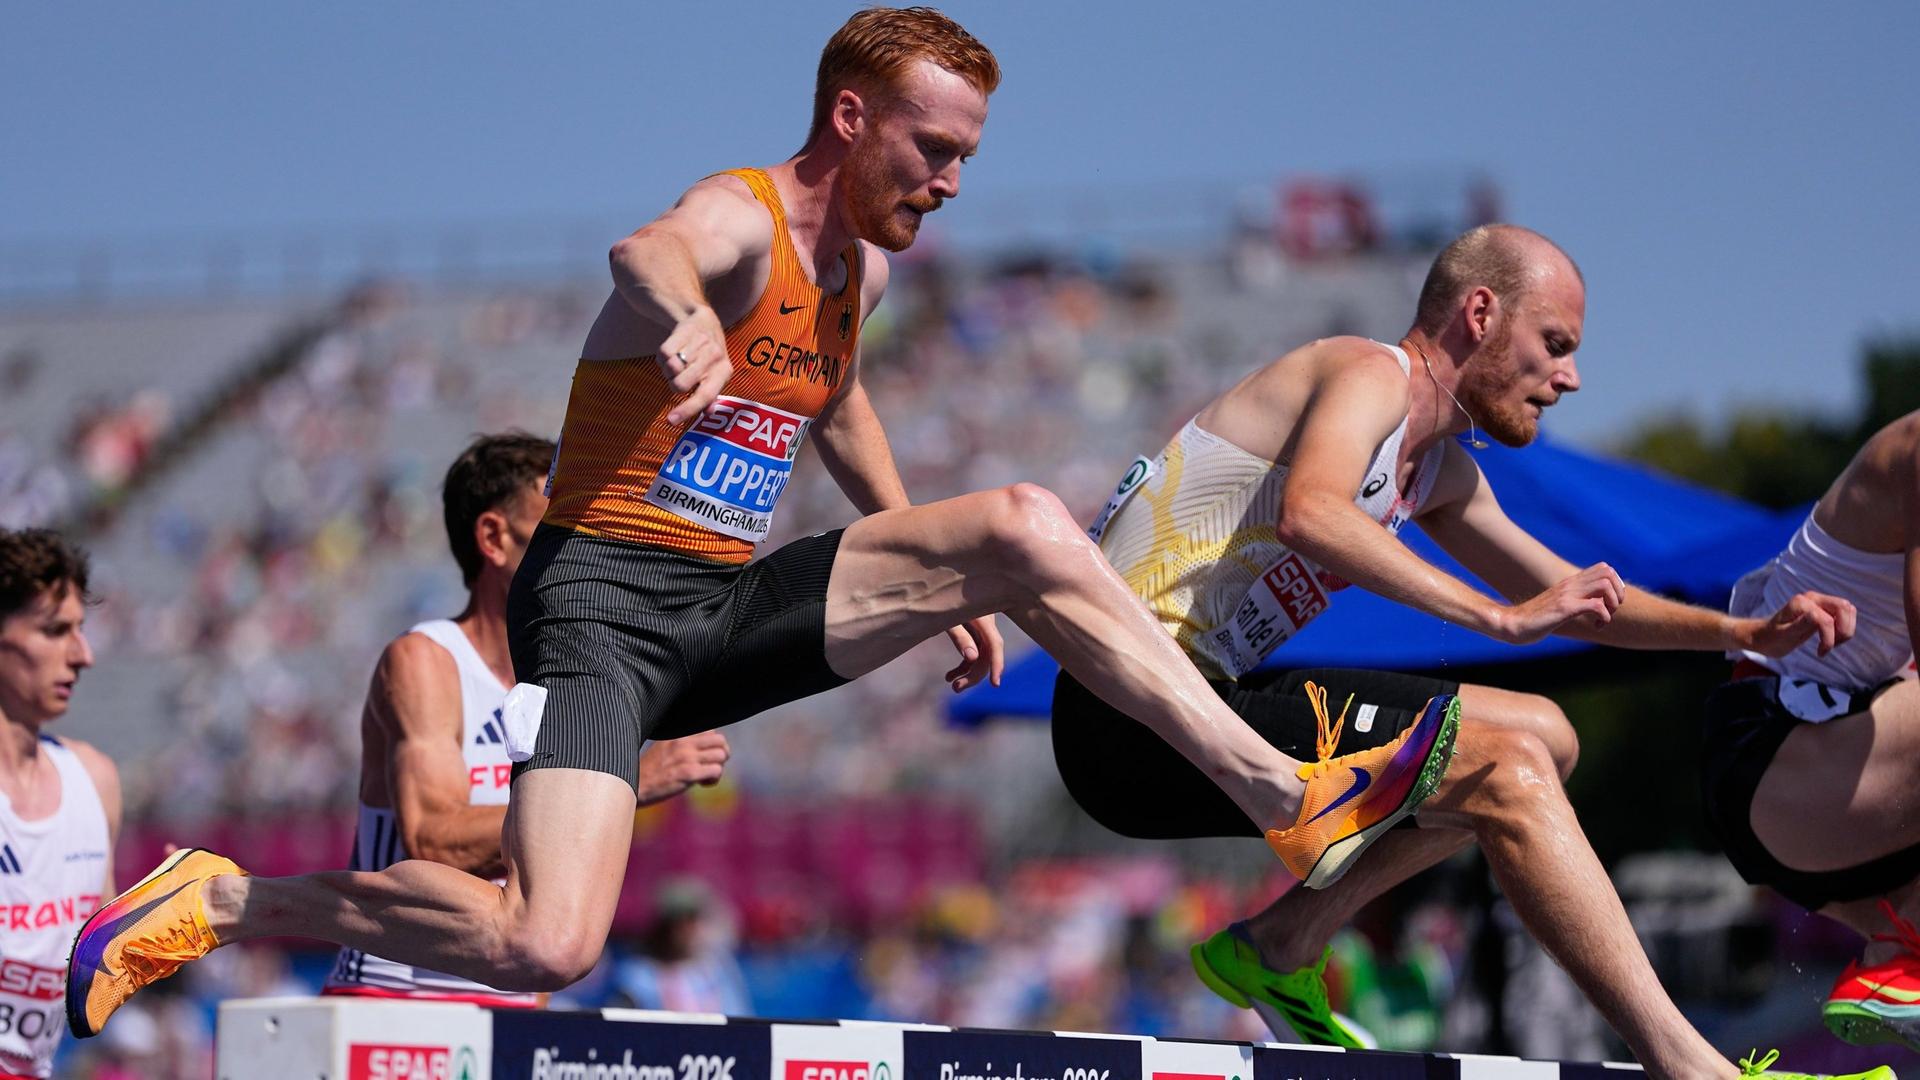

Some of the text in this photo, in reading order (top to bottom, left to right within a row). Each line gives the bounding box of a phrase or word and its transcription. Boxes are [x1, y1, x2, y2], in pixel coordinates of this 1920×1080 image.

[701, 404, 797, 450] SPAR
[666, 440, 790, 507] RUPPERT
[656, 484, 758, 533] BIRMINGHAM
[1244, 614, 1278, 648] de
[368, 1050, 448, 1080] SPAR
[678, 1054, 736, 1080] 2026
